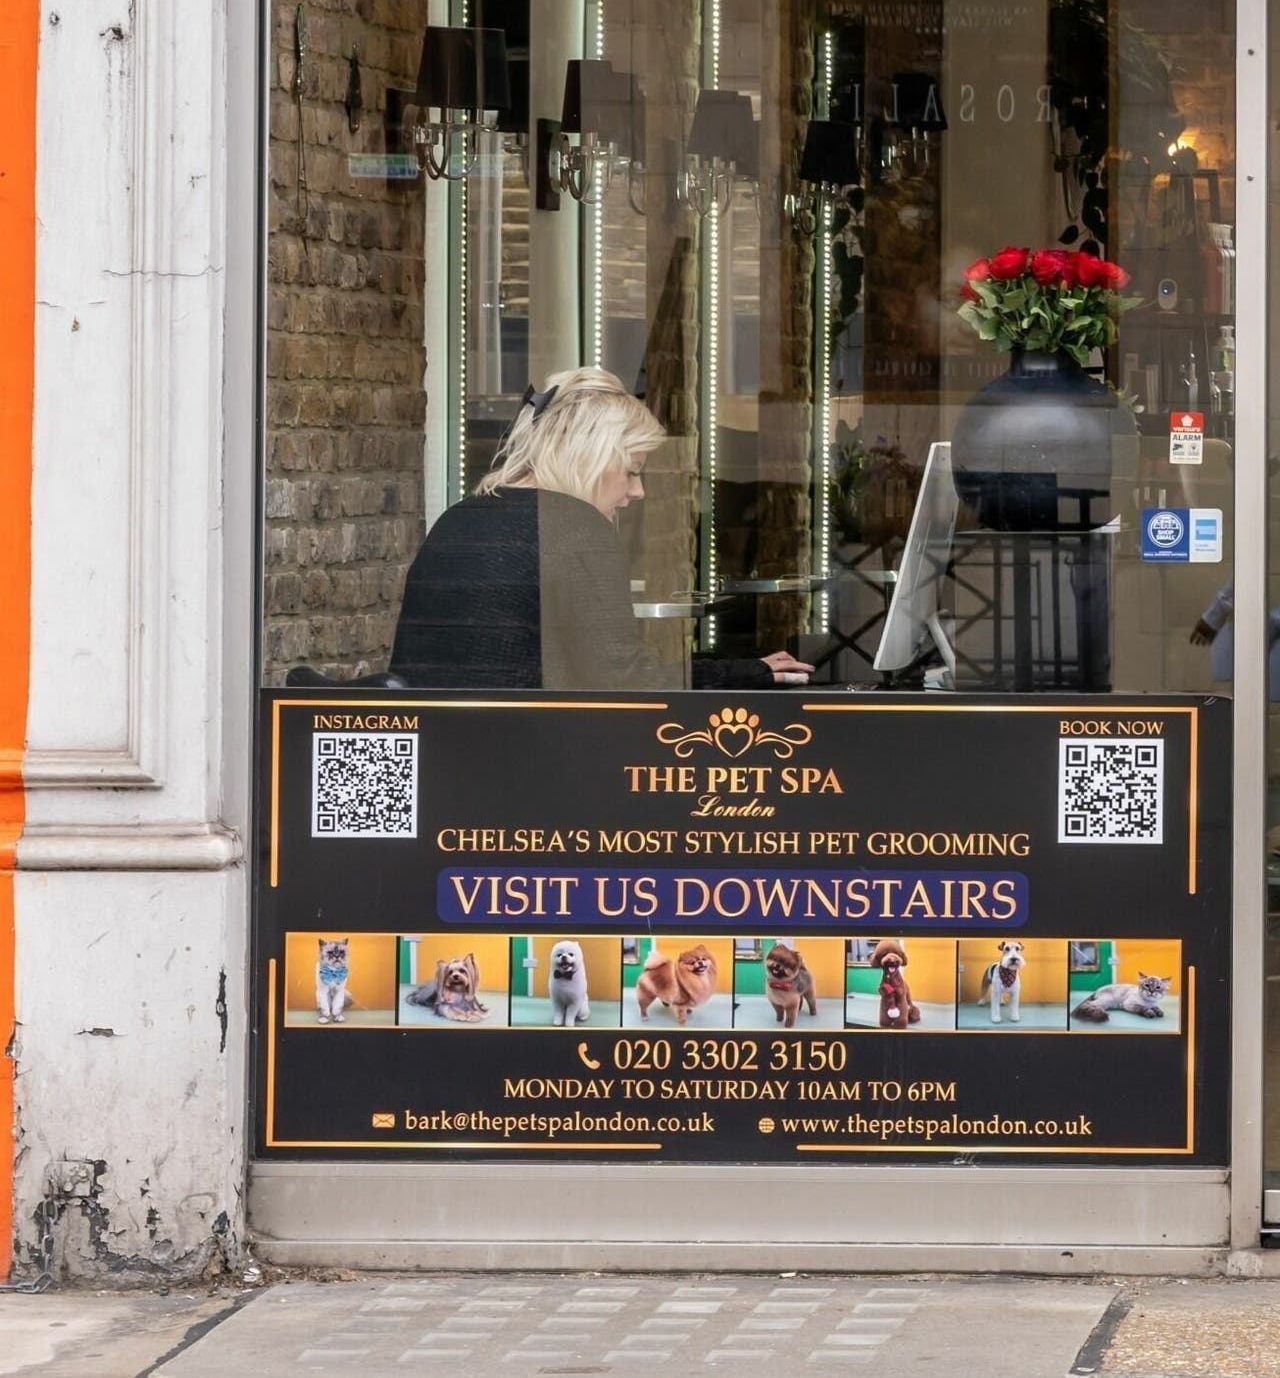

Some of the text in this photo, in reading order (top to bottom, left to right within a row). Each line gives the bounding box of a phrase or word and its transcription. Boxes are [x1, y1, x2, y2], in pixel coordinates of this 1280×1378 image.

[313, 715, 419, 730] INSTAGRAM
[1060, 721, 1164, 735] BOOK NOW
[624, 767, 843, 793] THE PET SPA
[690, 795, 775, 818] London
[599, 831, 677, 853] MOST
[686, 831, 800, 854] STYLISH
[809, 833, 859, 854] PET
[867, 833, 1029, 855] GROOMING
[450, 876, 1016, 919] VISIT US DOWNSTAIRS
[614, 1040, 846, 1070] 020 3302 3150
[504, 1079, 955, 1101] MONDAY TO SATURDAY 10AM TO 6PM
[405, 1110, 714, 1137] bark@thepetspalondon.co.uk
[782, 1114, 1091, 1140] www.thepetspalondon.co.uk
